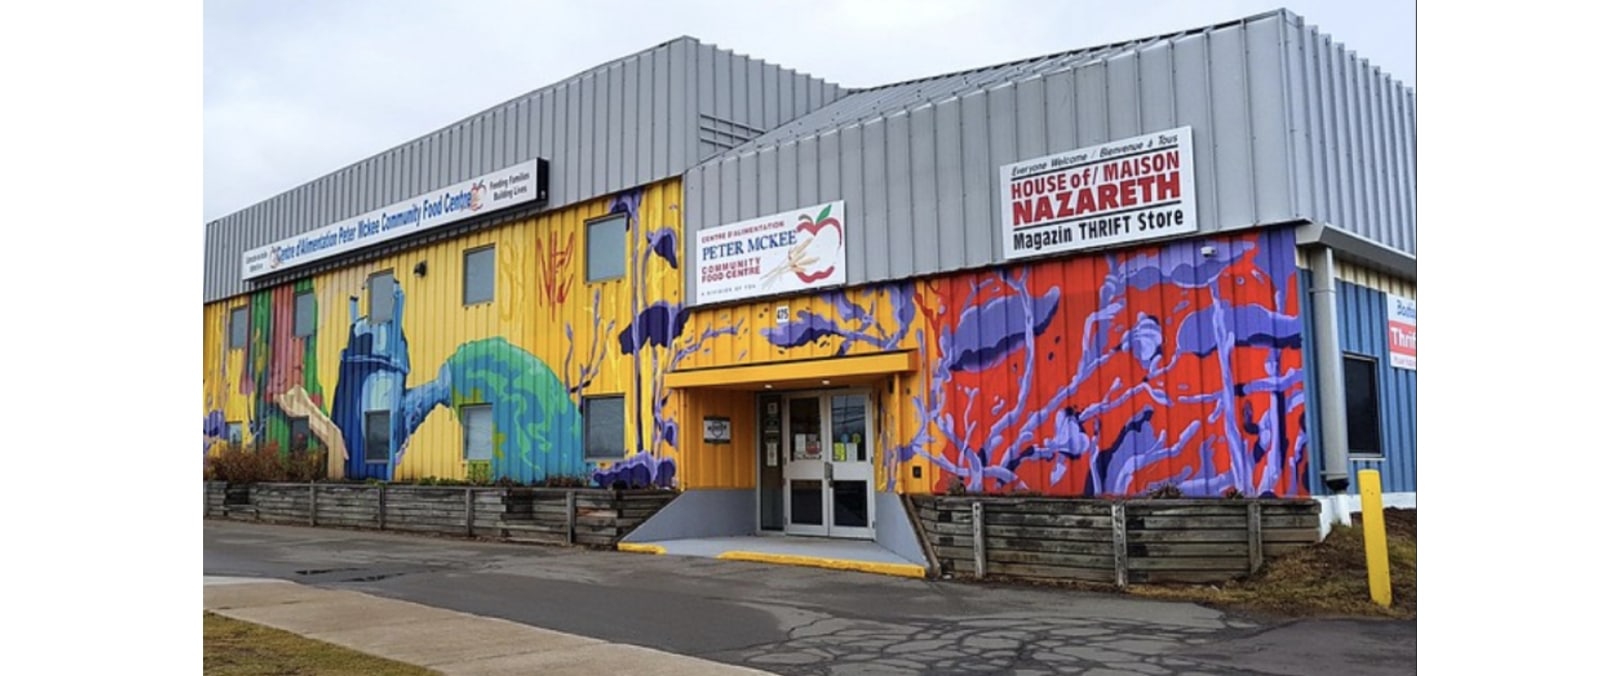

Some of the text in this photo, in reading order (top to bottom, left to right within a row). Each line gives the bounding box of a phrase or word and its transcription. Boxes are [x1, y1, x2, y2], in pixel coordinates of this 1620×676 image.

[1011, 173, 1067, 200] HOUSE
[1103, 150, 1180, 182] MAISON
[1012, 162, 1047, 177] Everyone
[1051, 153, 1088, 168] Welcome
[1099, 141, 1143, 158] Bienvenue
[1158, 134, 1178, 146] Tous
[339, 225, 356, 245] Peter
[381, 203, 422, 232] Community
[423, 195, 443, 220] Food
[1012, 171, 1181, 226] NAZARETH
[701, 232, 726, 244] CENTRE
[702, 229, 798, 261] PETER MCKEE
[1013, 208, 1184, 251] Magazin THRIFT Store
[701, 257, 761, 275] COMMUNITY
[701, 266, 761, 284] FOOD CENTRE
